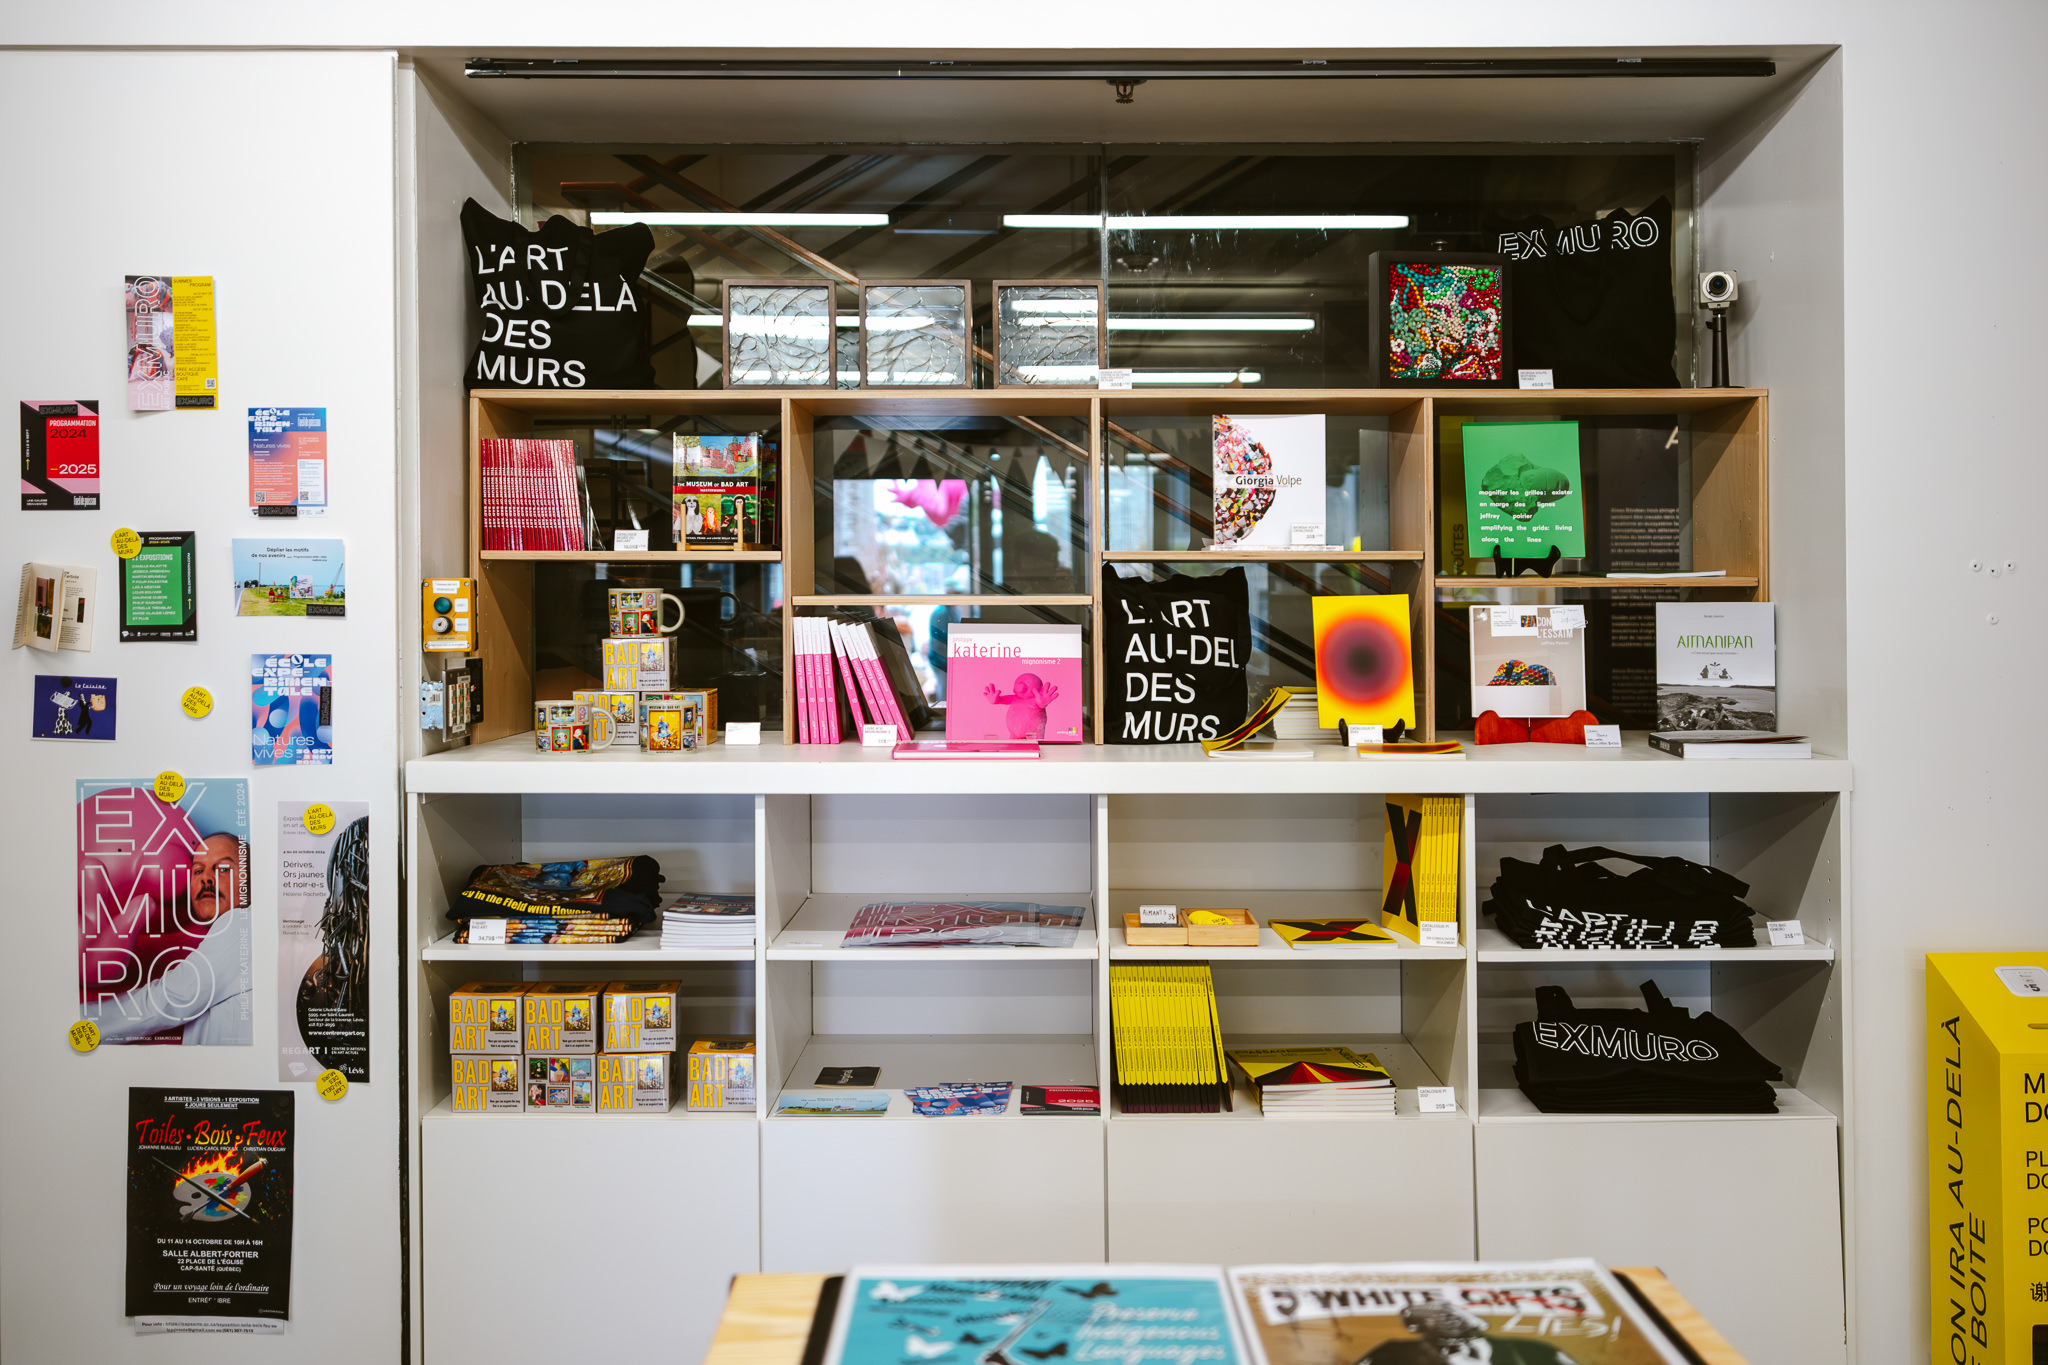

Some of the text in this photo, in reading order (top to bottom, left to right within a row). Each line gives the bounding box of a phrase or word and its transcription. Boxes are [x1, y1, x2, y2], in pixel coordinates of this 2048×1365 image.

[475, 244, 568, 274] L'ART
[481, 275, 637, 312] AUDELÀ
[134, 276, 163, 409] EXMURO
[482, 313, 551, 349] DES
[477, 351, 586, 387] MURS
[50, 429, 86, 438] 2024
[1236, 475, 1302, 487] Giorgia Volpe
[1122, 599, 1211, 627] L'RT
[604, 643, 638, 665] BAD
[954, 643, 1021, 657] katerine
[1125, 633, 1245, 669] AU-DEL
[606, 667, 638, 689] ART
[1126, 672, 1196, 702] DES
[253, 734, 314, 745] Natures
[1123, 711, 1220, 741] MURS
[254, 748, 293, 758] vives
[237, 783, 245, 804] 2024
[81, 782, 209, 855] EX
[238, 834, 247, 905] MIGNONNISME
[82, 865, 233, 938] MU
[474, 891, 486, 900] in
[486, 895, 502, 905] the
[503, 898, 528, 912] Field
[527, 905, 550, 914] with
[239, 927, 249, 979] KATERINE
[83, 946, 215, 1021] RO
[451, 999, 488, 1023] BAD
[526, 999, 562, 1024] BAD
[605, 998, 642, 1023] BAD
[453, 1026, 488, 1050] ART
[527, 1026, 562, 1050] ART
[607, 1024, 642, 1049] ART
[1532, 1021, 1719, 1062] EXMURO
[453, 1058, 489, 1084] BAD
[454, 1086, 489, 1110] ART
[1941, 1016, 1965, 1209] AU-DELÀ
[136, 1115, 287, 1148] Toiles Bois Feux
[1949, 1221, 1966, 1288] IRA
[184, 1284, 208, 1292] voyage
[210, 1282, 223, 1291] loin
[1969, 1212, 1987, 1349] BOITE
[1308, 1286, 1443, 1309] WHITE
